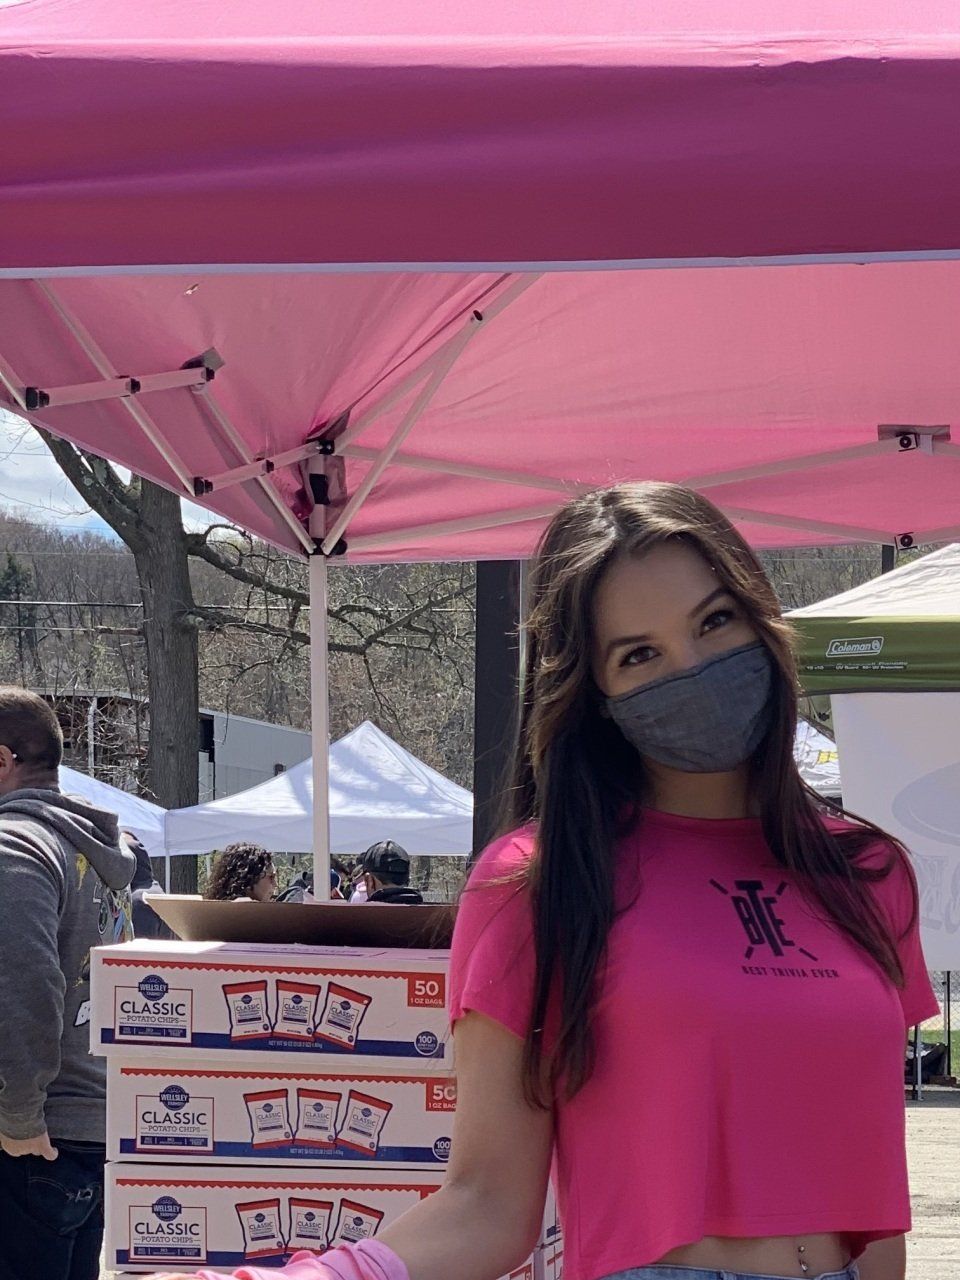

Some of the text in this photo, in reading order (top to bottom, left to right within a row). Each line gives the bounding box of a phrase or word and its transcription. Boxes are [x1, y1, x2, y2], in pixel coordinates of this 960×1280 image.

[832, 641, 871, 652] Coleman
[731, 880, 795, 957] BTE
[742, 966, 839, 978] BEST TRIVIA EVER
[414, 981, 439, 996] 50
[120, 1001, 186, 1016] CLASSIC
[127, 1015, 155, 1023] POTATO
[141, 1111, 207, 1125] CLASSIC
[148, 1125, 178, 1133] POTATO
[134, 1222, 200, 1236] CLASSIC
[172, 1236, 193, 1244] CHIPS
